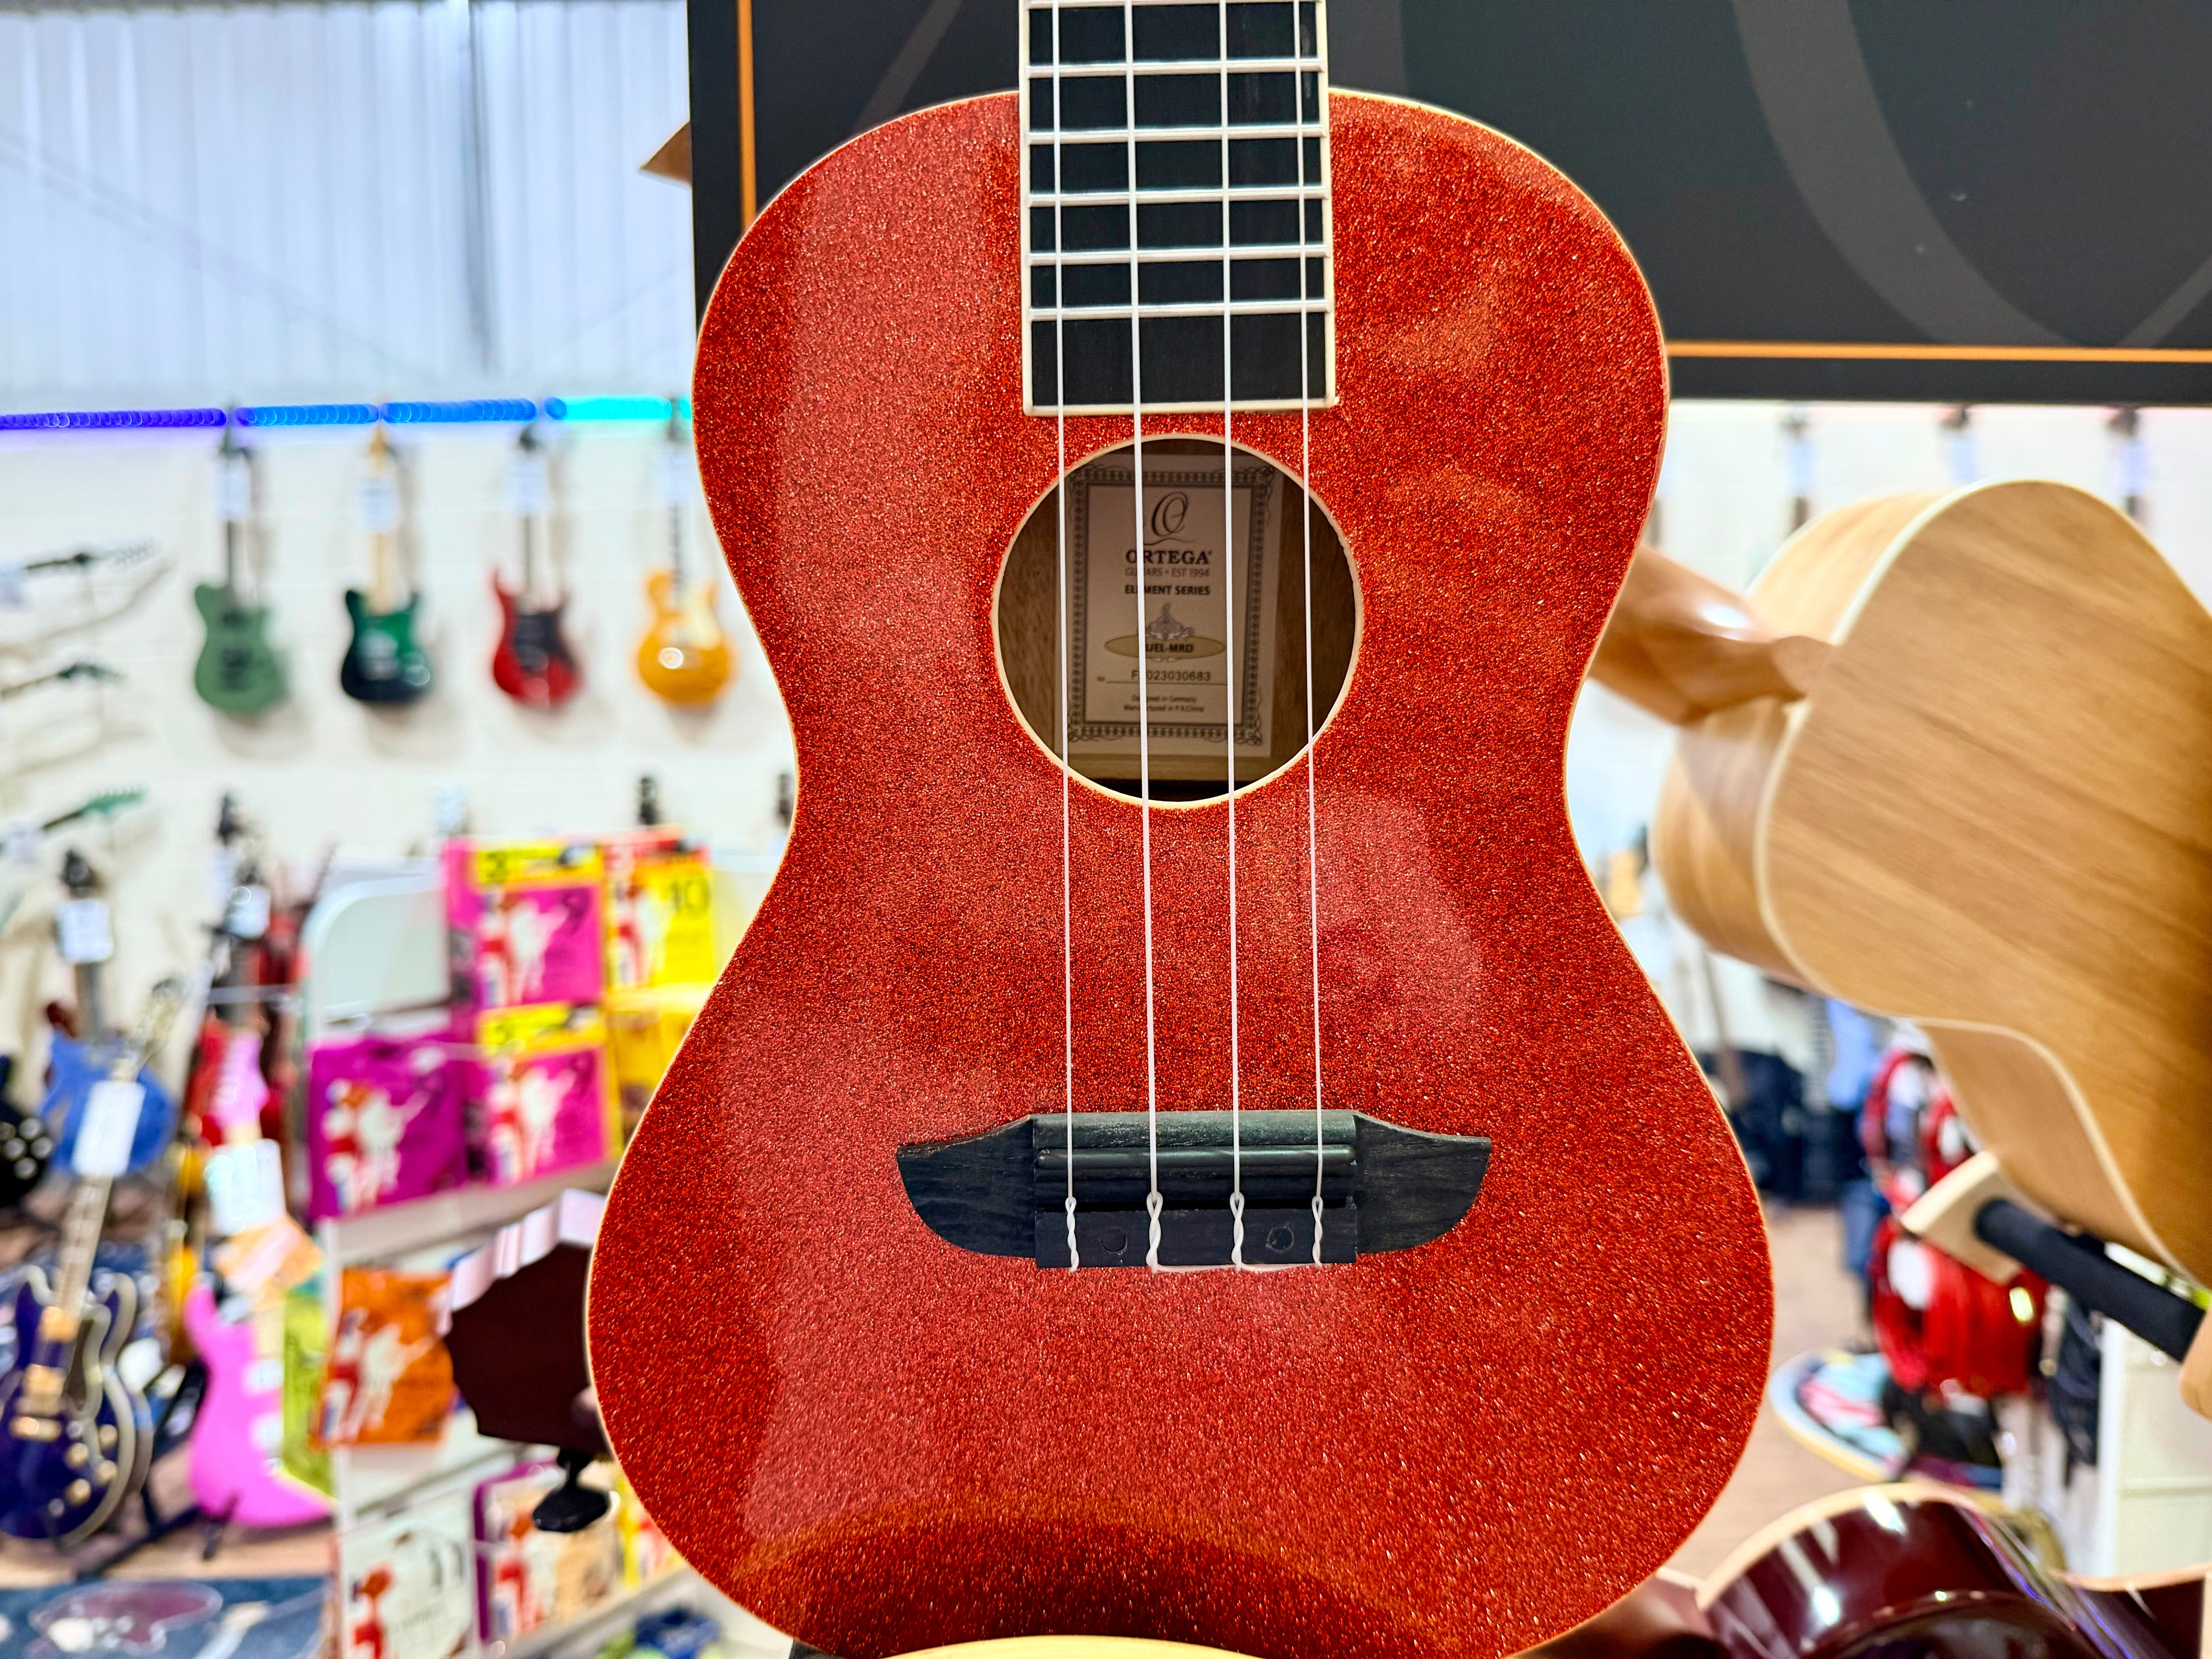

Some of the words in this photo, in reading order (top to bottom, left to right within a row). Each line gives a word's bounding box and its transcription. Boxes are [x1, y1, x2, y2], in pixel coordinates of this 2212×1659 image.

[1125, 585, 1172, 594] ELMENT
[1175, 586, 1210, 595] SERIES
[1131, 670, 1211, 681] F023030683
